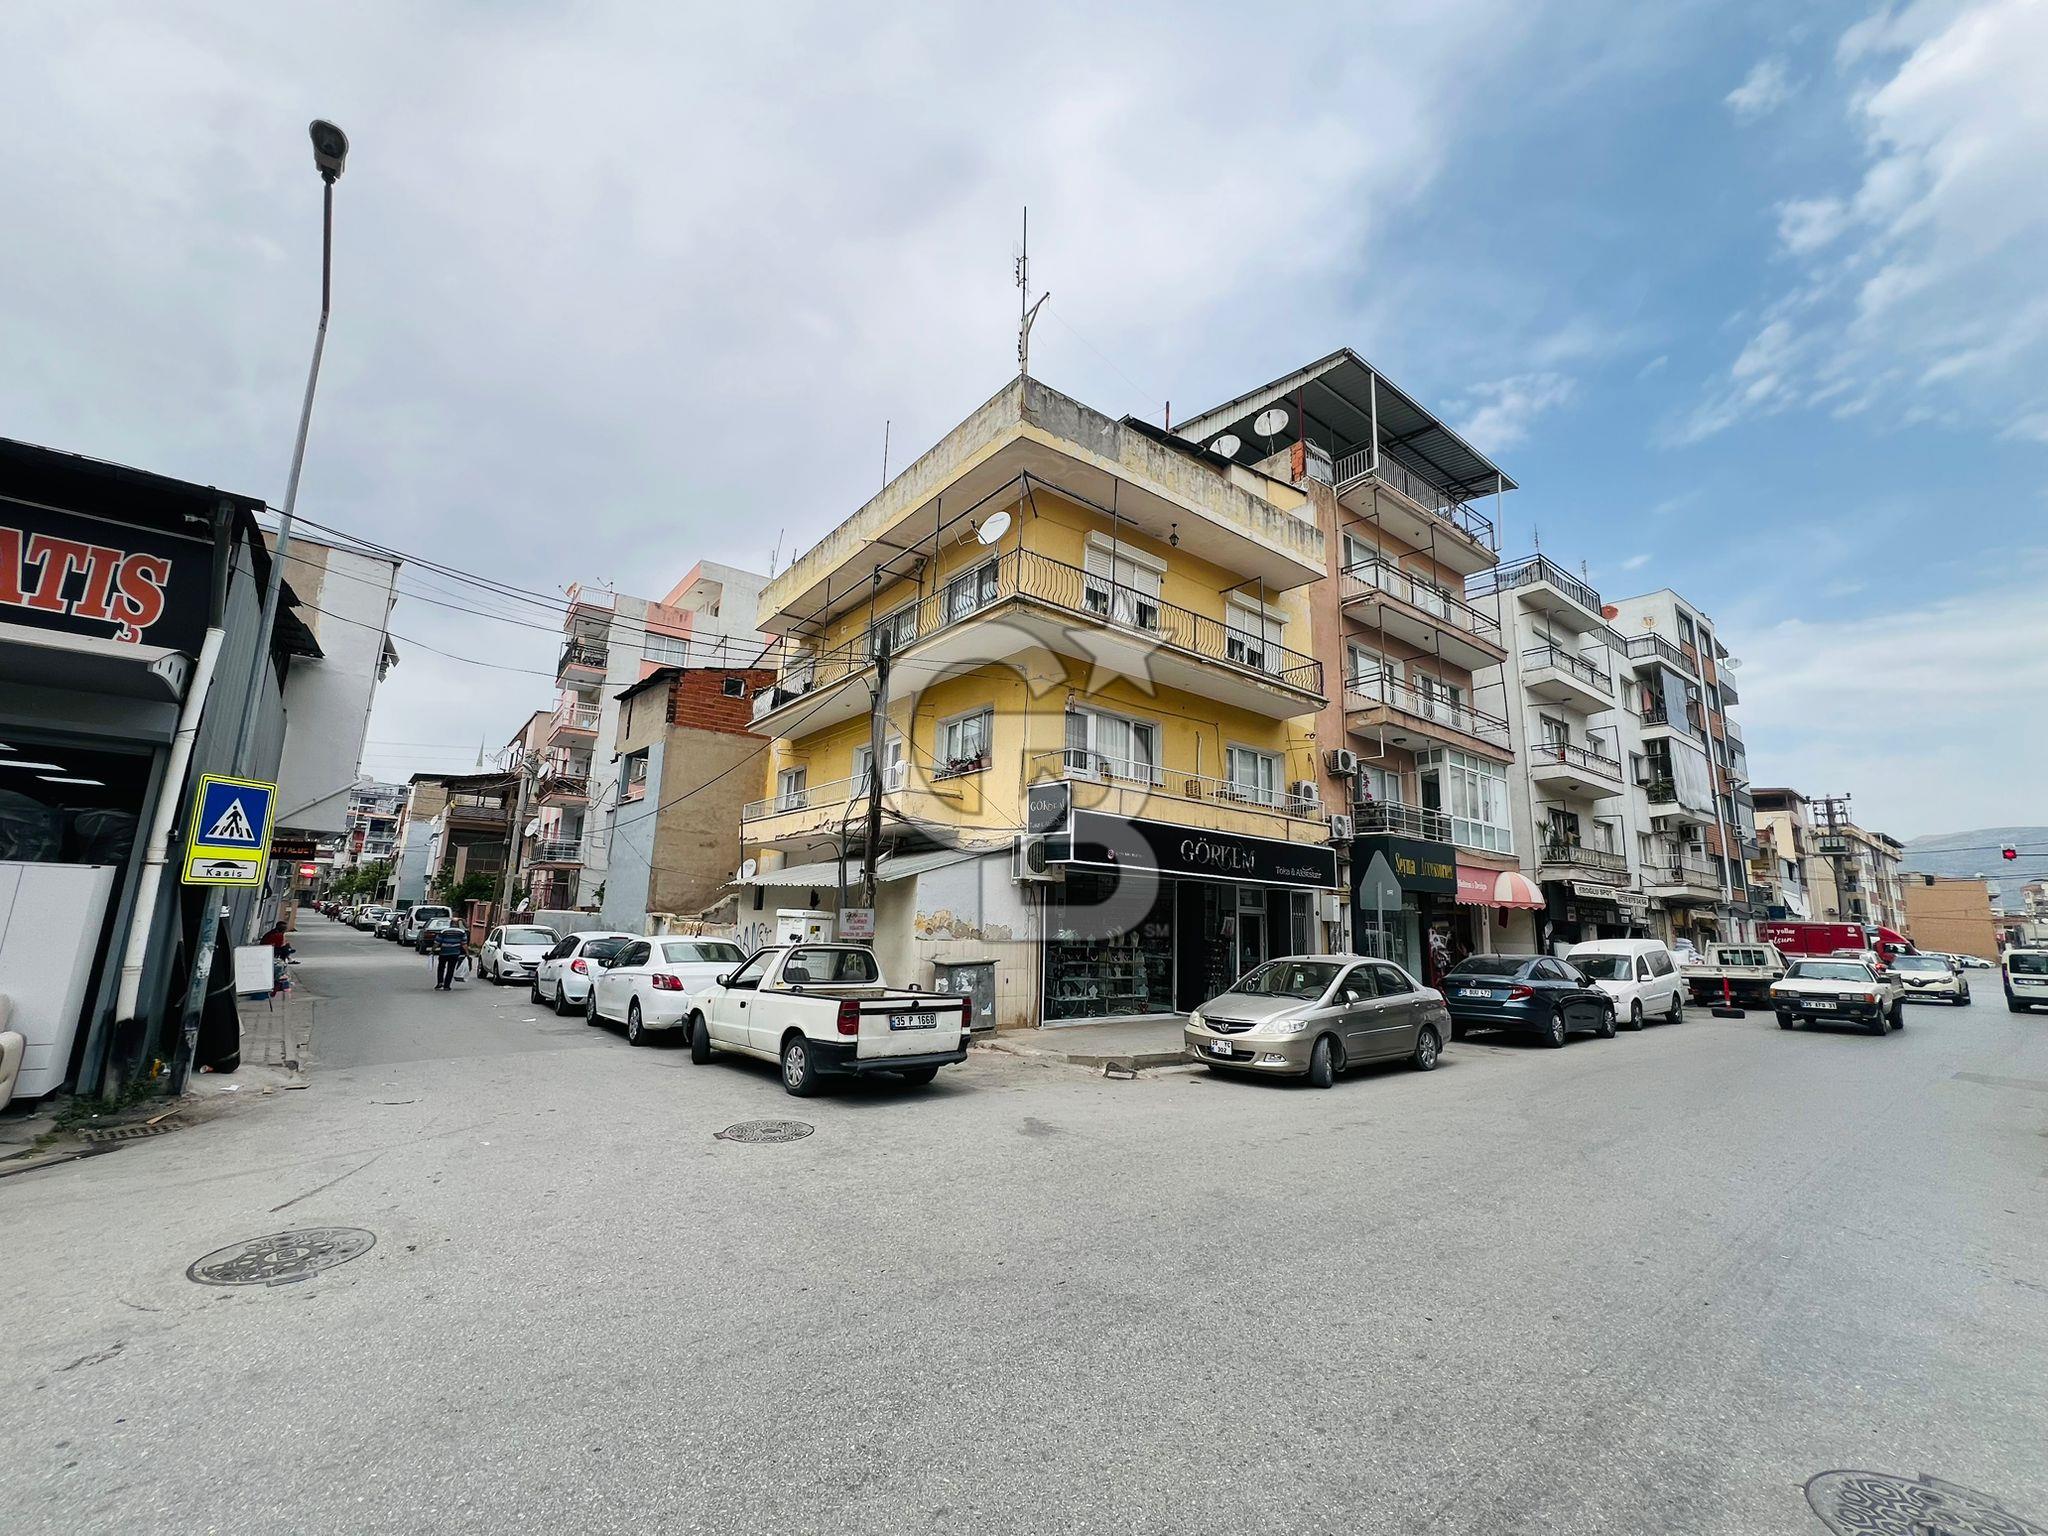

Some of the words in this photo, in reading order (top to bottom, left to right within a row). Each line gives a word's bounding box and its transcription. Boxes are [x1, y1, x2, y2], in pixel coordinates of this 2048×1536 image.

[206, 868, 242, 877] Kasis
[895, 1016, 905, 1026] 35
[909, 1015, 914, 1026] P
